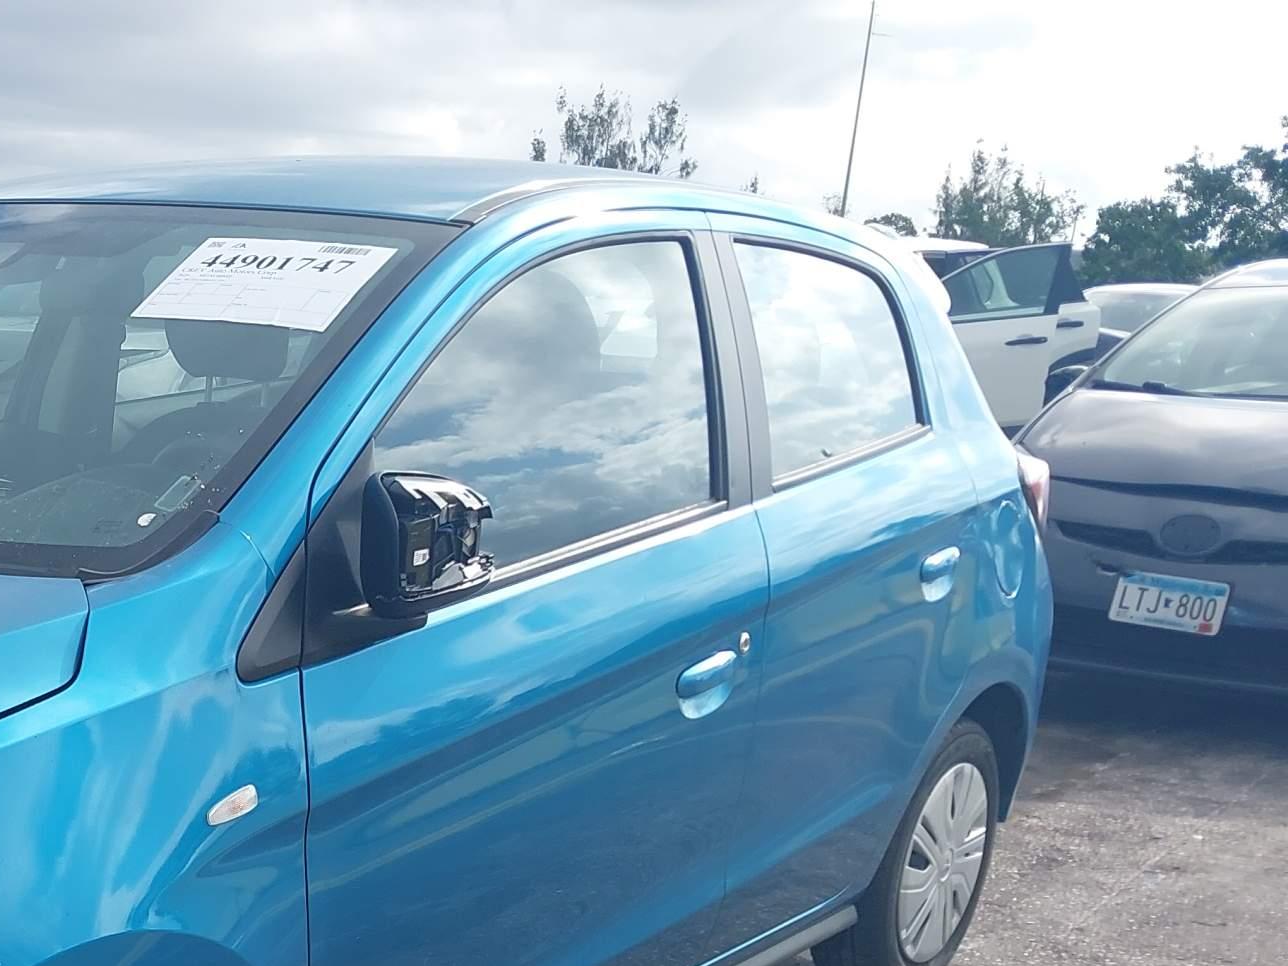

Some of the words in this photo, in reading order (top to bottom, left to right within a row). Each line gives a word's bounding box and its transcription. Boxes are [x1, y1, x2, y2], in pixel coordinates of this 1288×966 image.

[201, 254, 357, 274] 44901747
[1118, 585, 1162, 613] LTJ
[1176, 593, 1218, 622] 800
